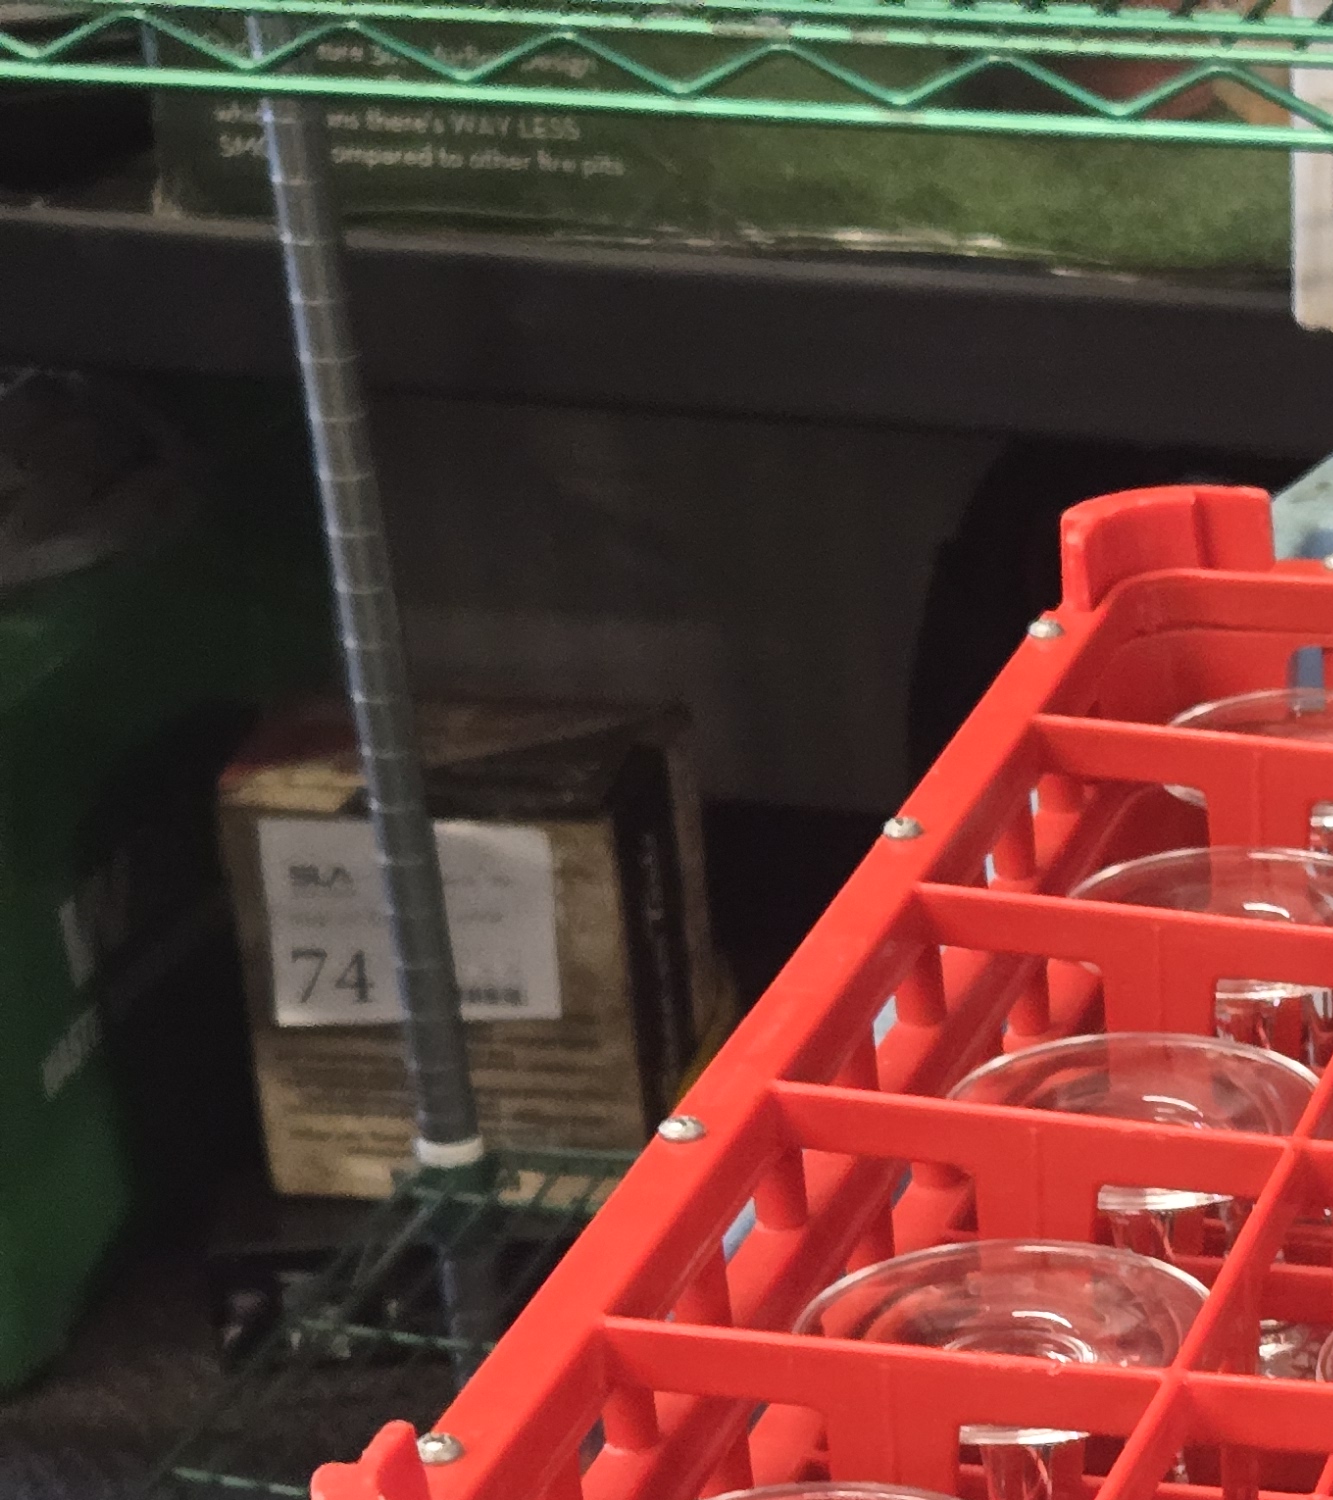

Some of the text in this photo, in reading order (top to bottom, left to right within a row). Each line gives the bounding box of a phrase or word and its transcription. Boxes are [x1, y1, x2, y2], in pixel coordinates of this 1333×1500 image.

[517, 113, 581, 142] LESS
[330, 144, 434, 169] ompared
[438, 147, 464, 169] to
[290, 946, 375, 1005] 74
